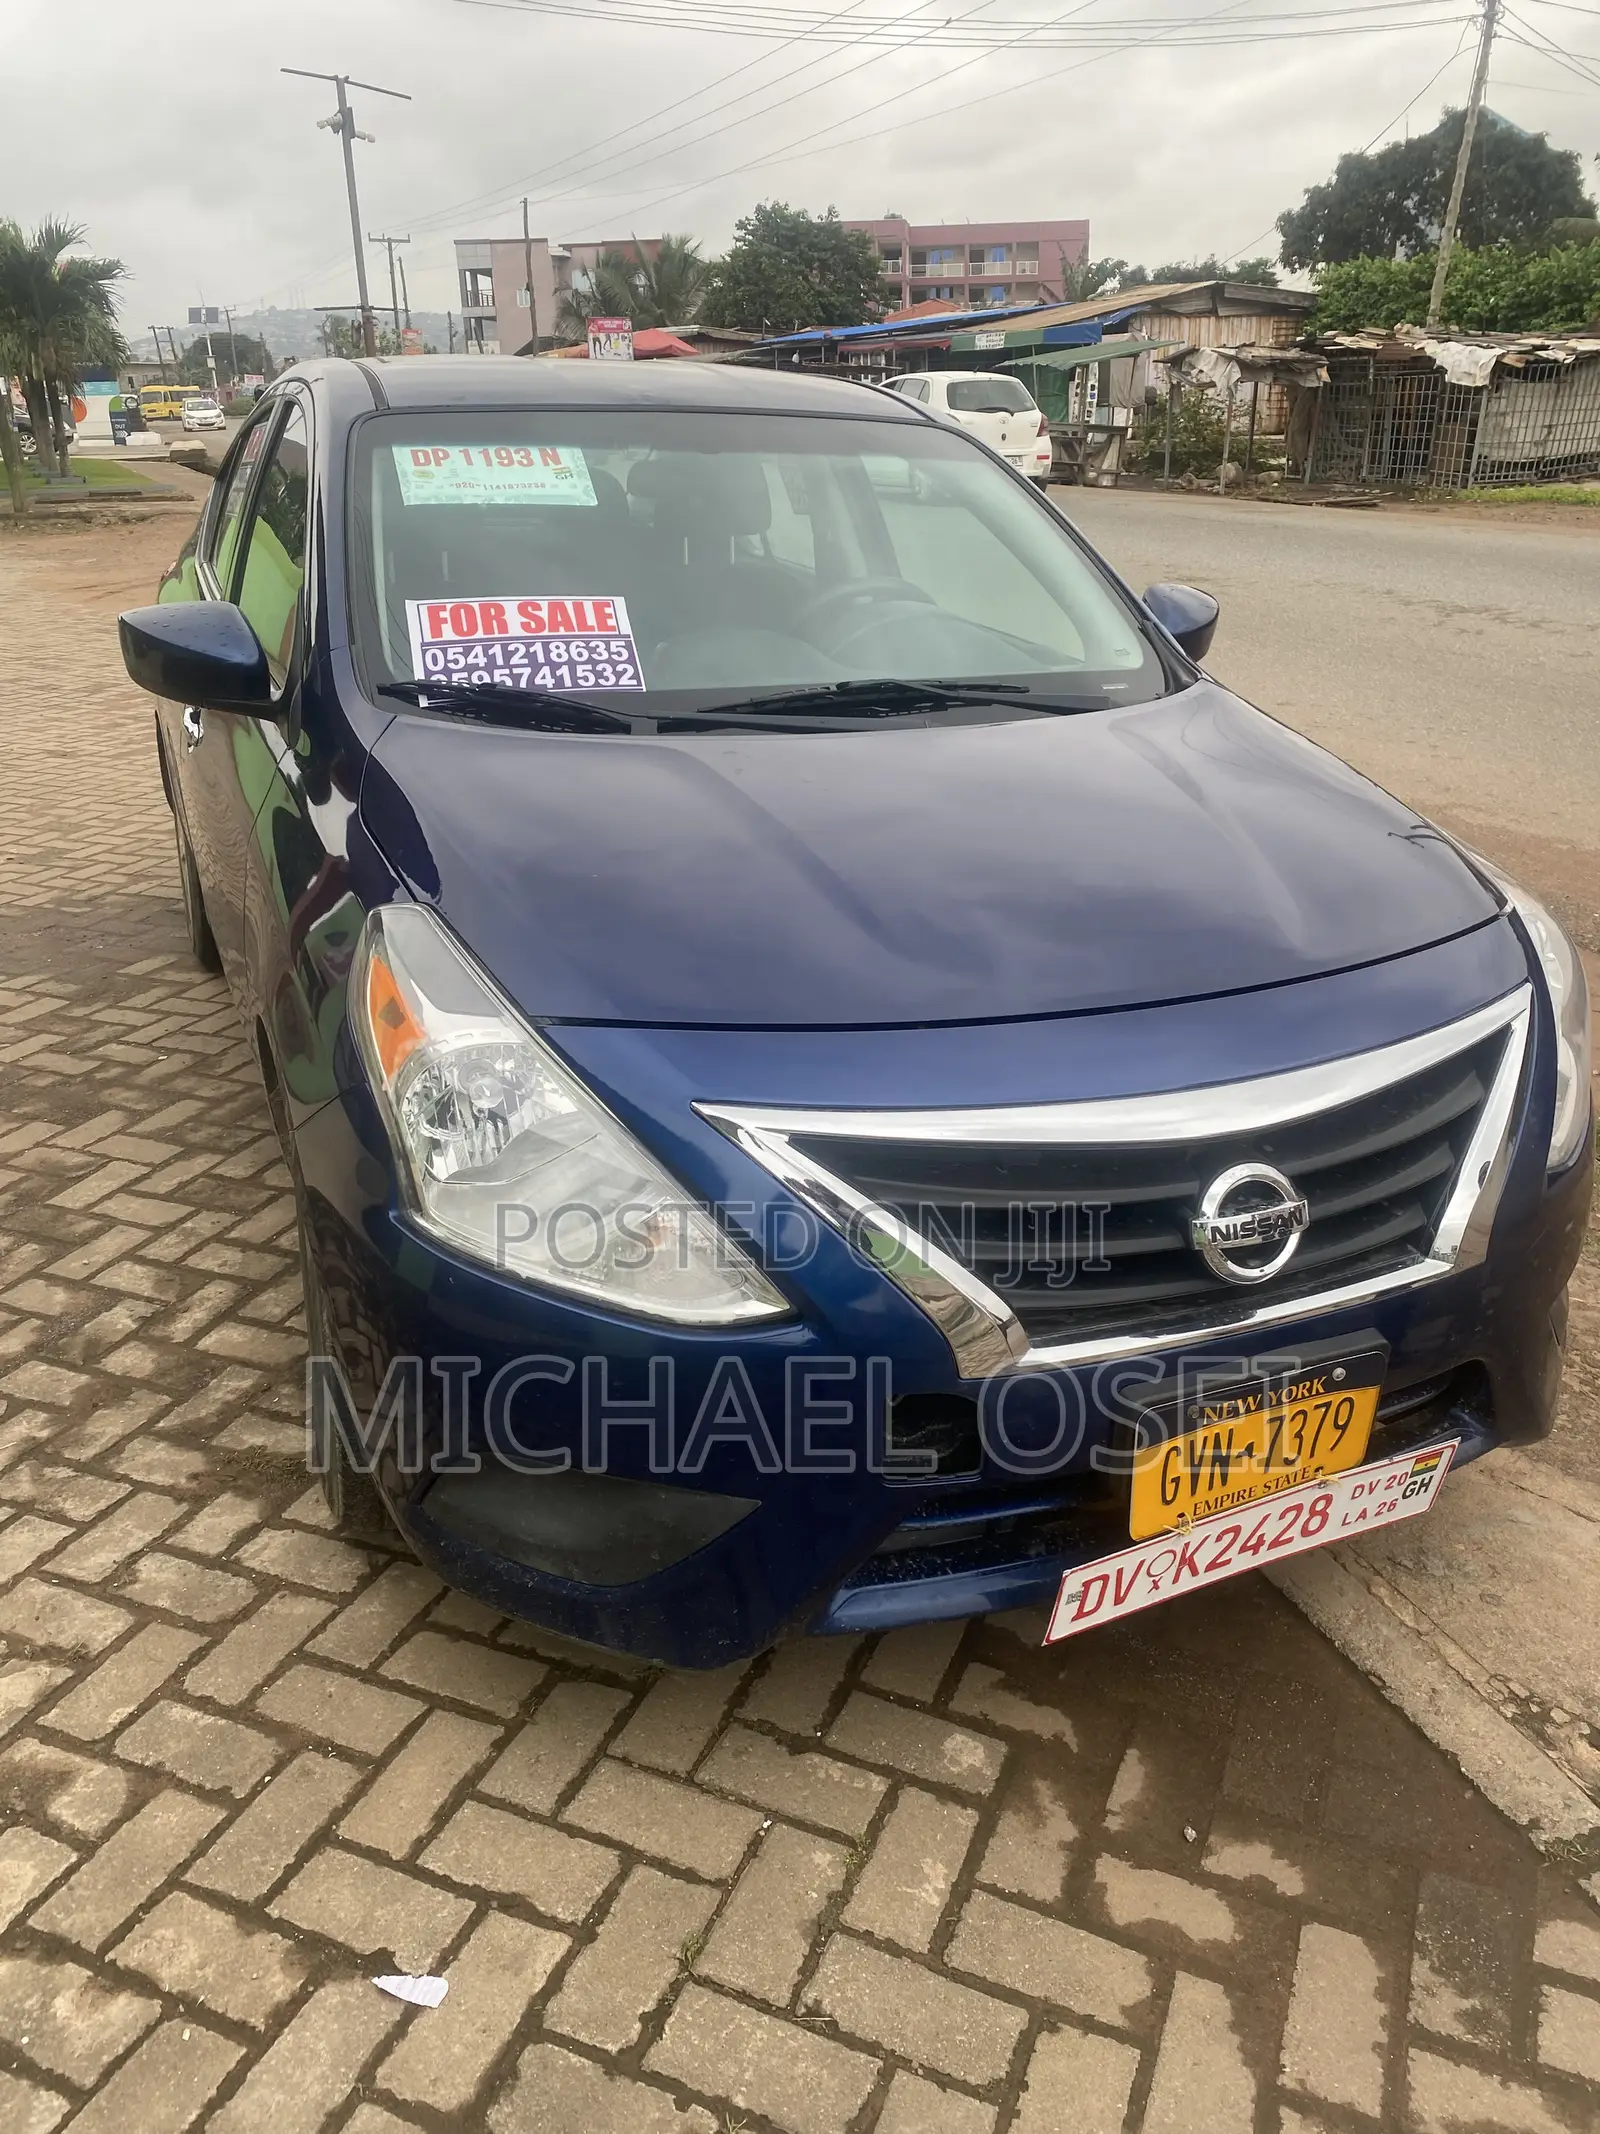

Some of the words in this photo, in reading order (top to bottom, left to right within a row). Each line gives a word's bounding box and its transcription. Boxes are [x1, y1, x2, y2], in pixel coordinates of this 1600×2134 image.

[410, 447, 450, 467] DP
[458, 447, 534, 467] 1193
[539, 447, 562, 466] N
[427, 602, 509, 639] FOR
[517, 601, 617, 634] SALE
[425, 641, 629, 671] 0541218635
[1210, 1207, 1303, 1243] NISSAN
[1203, 1393, 1262, 1425] NEW
[1267, 1376, 1328, 1405] YORK
[1192, 1484, 1258, 1517] EMPIRE
[1262, 1465, 1311, 1493] STATE
[1351, 1478, 1382, 1500] DV
[1384, 1471, 1409, 1491] 20
[1401, 1475, 1434, 1500] GH
[1341, 1507, 1368, 1526] LA
[1374, 1498, 1399, 1517] 26
[1171, 1492, 1334, 1585] K2428
